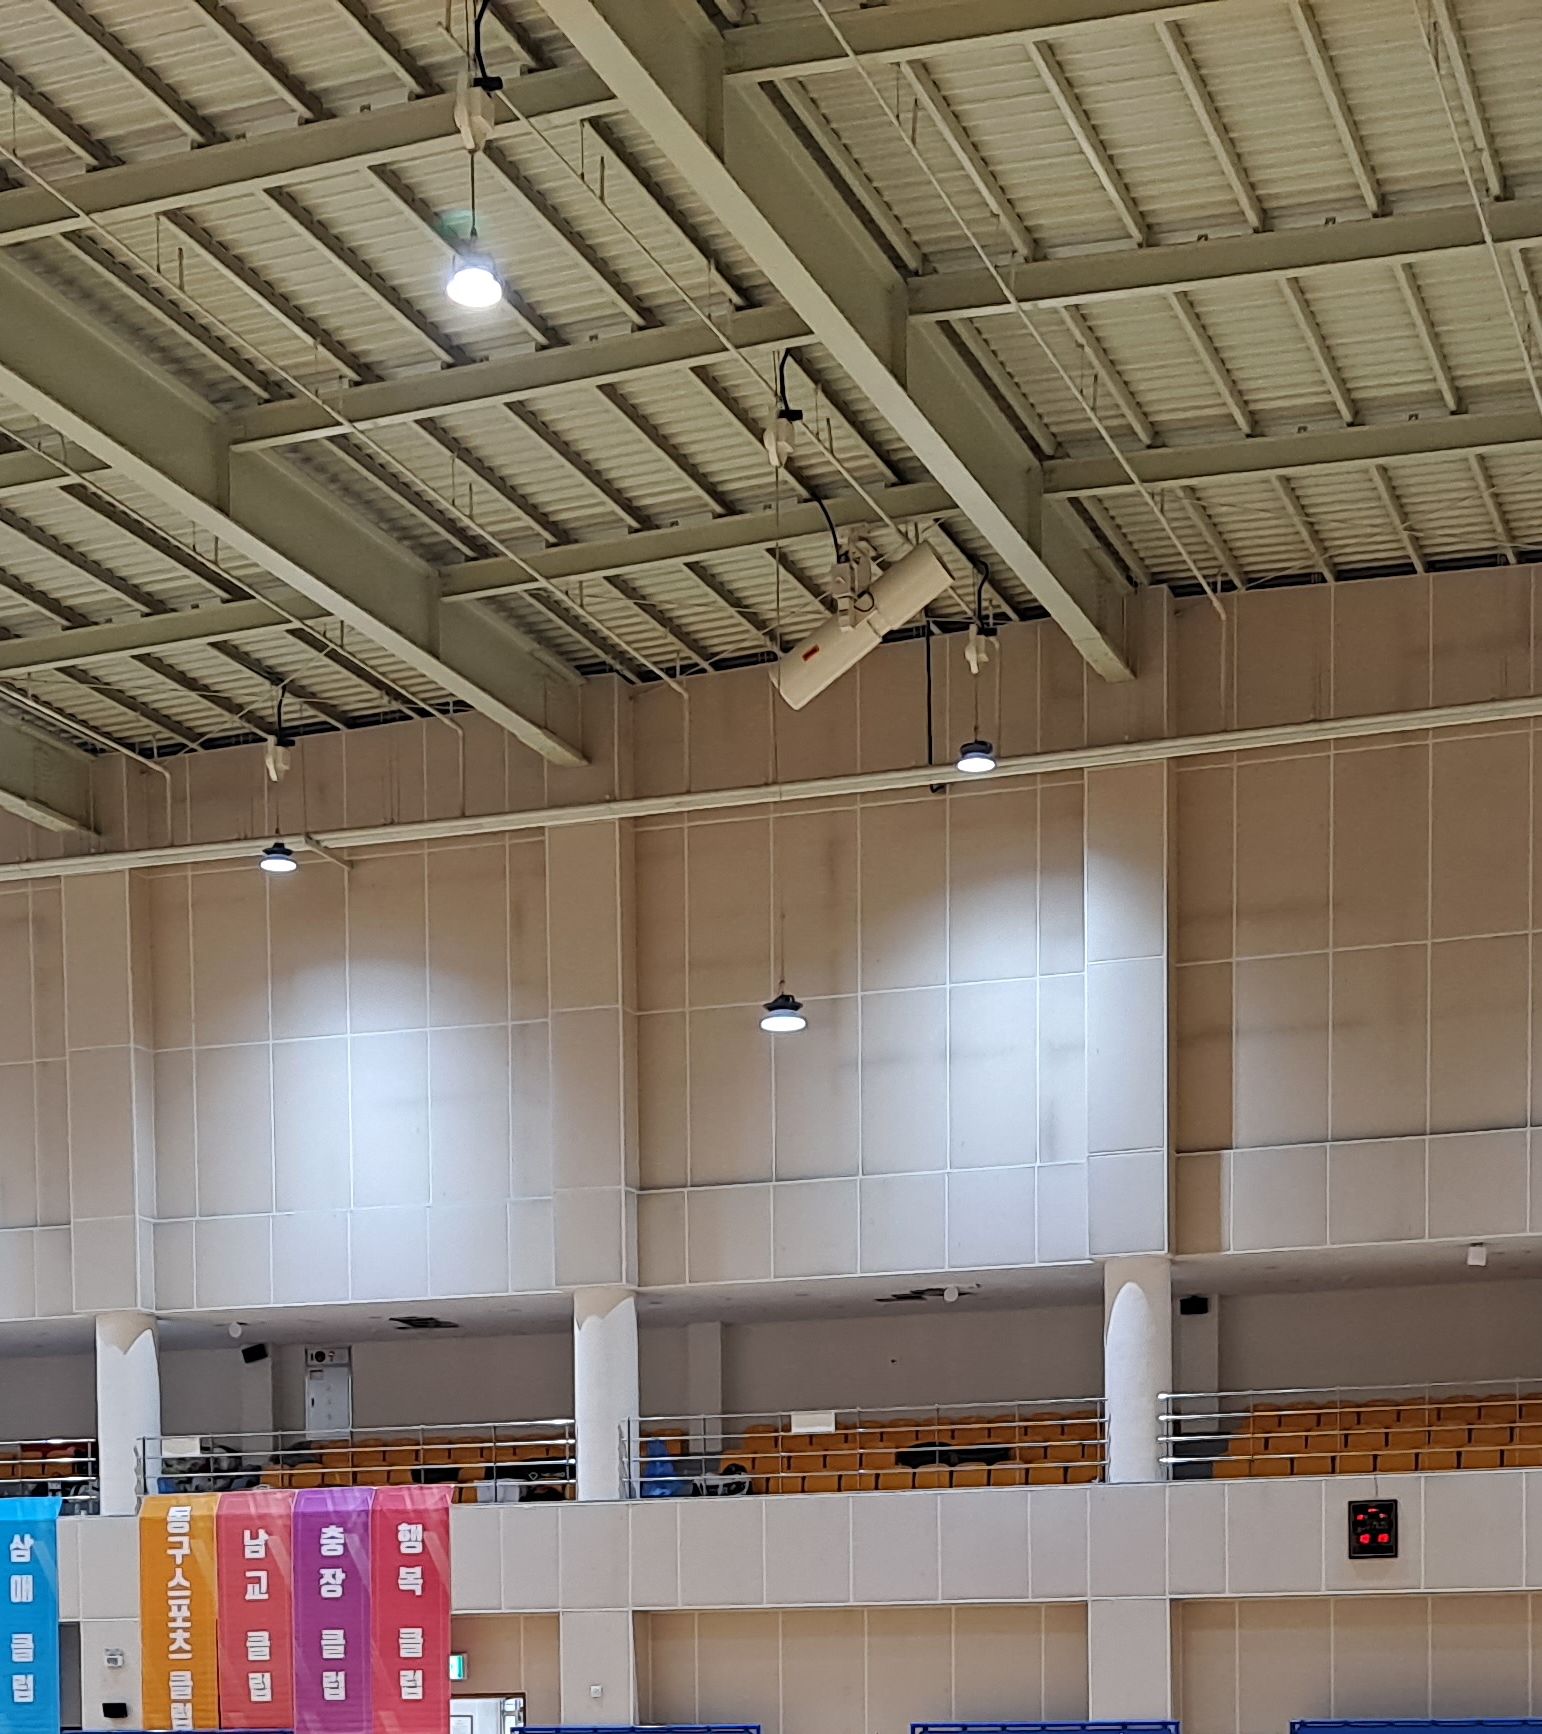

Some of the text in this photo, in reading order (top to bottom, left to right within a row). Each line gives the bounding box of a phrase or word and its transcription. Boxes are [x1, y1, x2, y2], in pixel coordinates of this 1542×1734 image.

[11, 1633, 35, 1703] 클럽
[166, 1505, 193, 1730] 동구스포츠 클럽
[246, 1630, 272, 1702] 클럽
[318, 1524, 346, 1701] 충장 클럽
[397, 1522, 424, 1700] 행복 클럽
